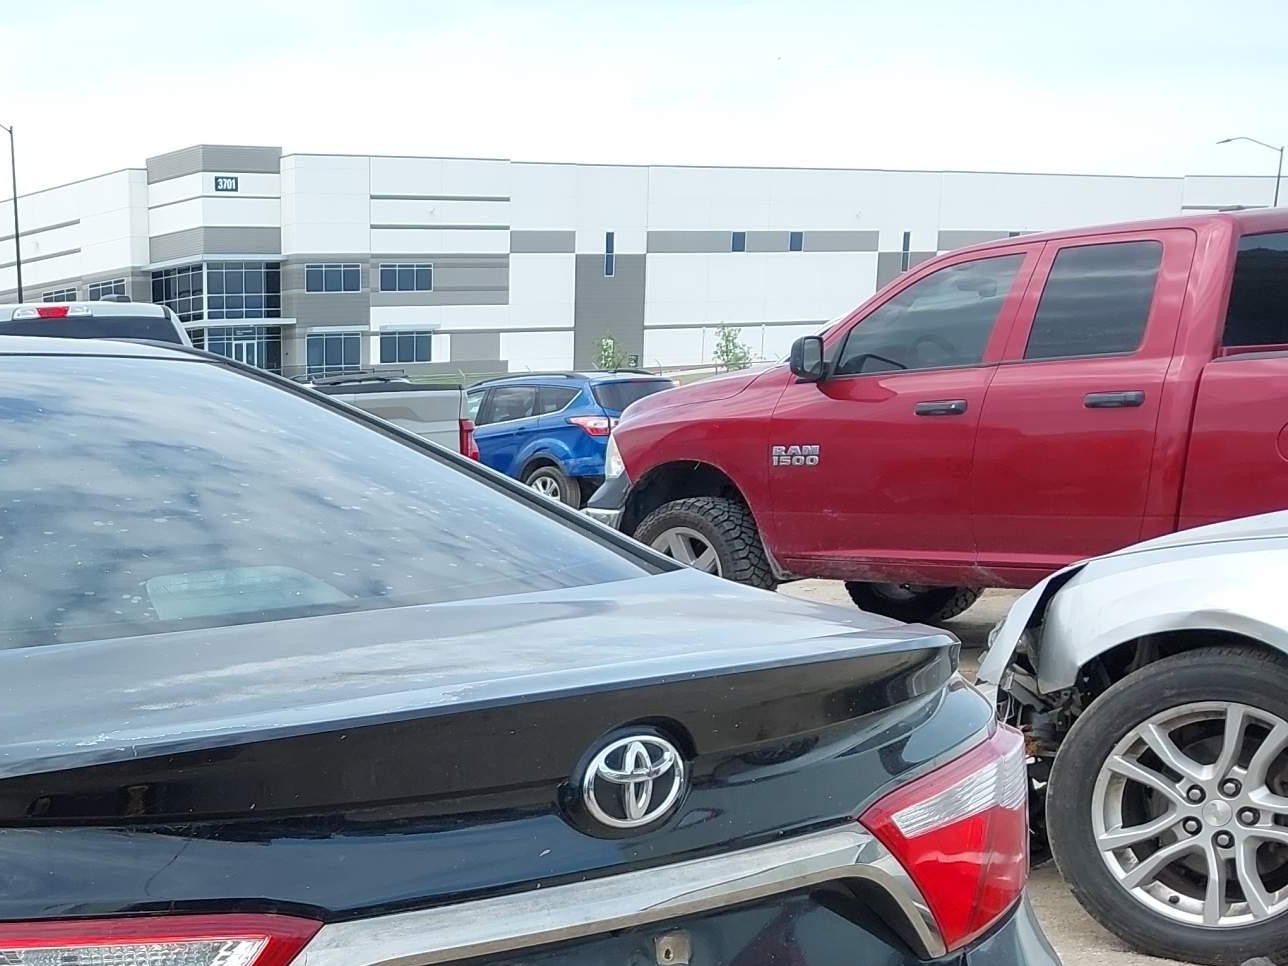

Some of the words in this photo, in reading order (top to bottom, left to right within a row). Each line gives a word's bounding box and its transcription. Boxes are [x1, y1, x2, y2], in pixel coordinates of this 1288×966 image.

[216, 178, 236, 190] 3701
[772, 444, 820, 456] RAM
[772, 455, 819, 466] 1500
